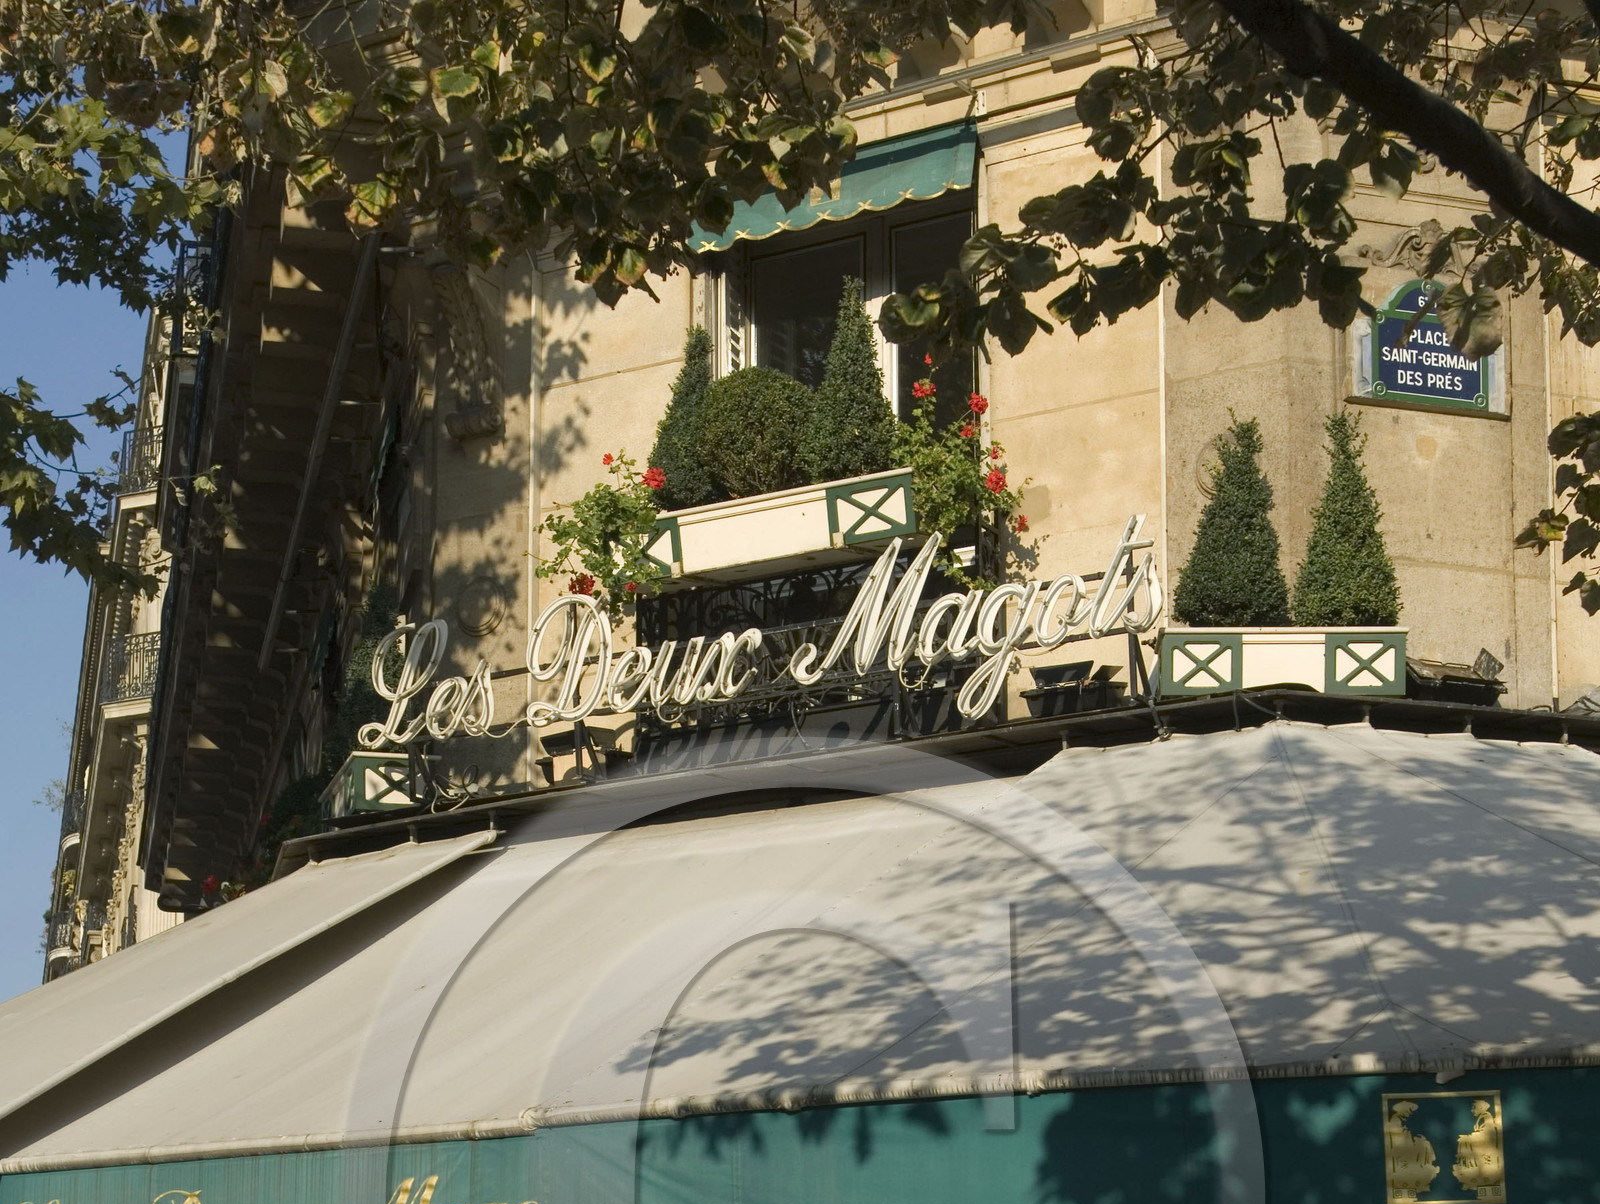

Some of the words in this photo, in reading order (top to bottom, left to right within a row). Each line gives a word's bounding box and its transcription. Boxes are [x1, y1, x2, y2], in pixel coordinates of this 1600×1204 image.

[1409, 329, 1450, 346] PLACE
[1382, 347, 1477, 371] SAINT-GERMAIN
[1397, 369, 1423, 386] DES
[1427, 372, 1463, 391] PRÉS
[358, 619, 495, 749] Les
[526, 594, 763, 727] Deux
[799, 513, 1163, 722] Magots
